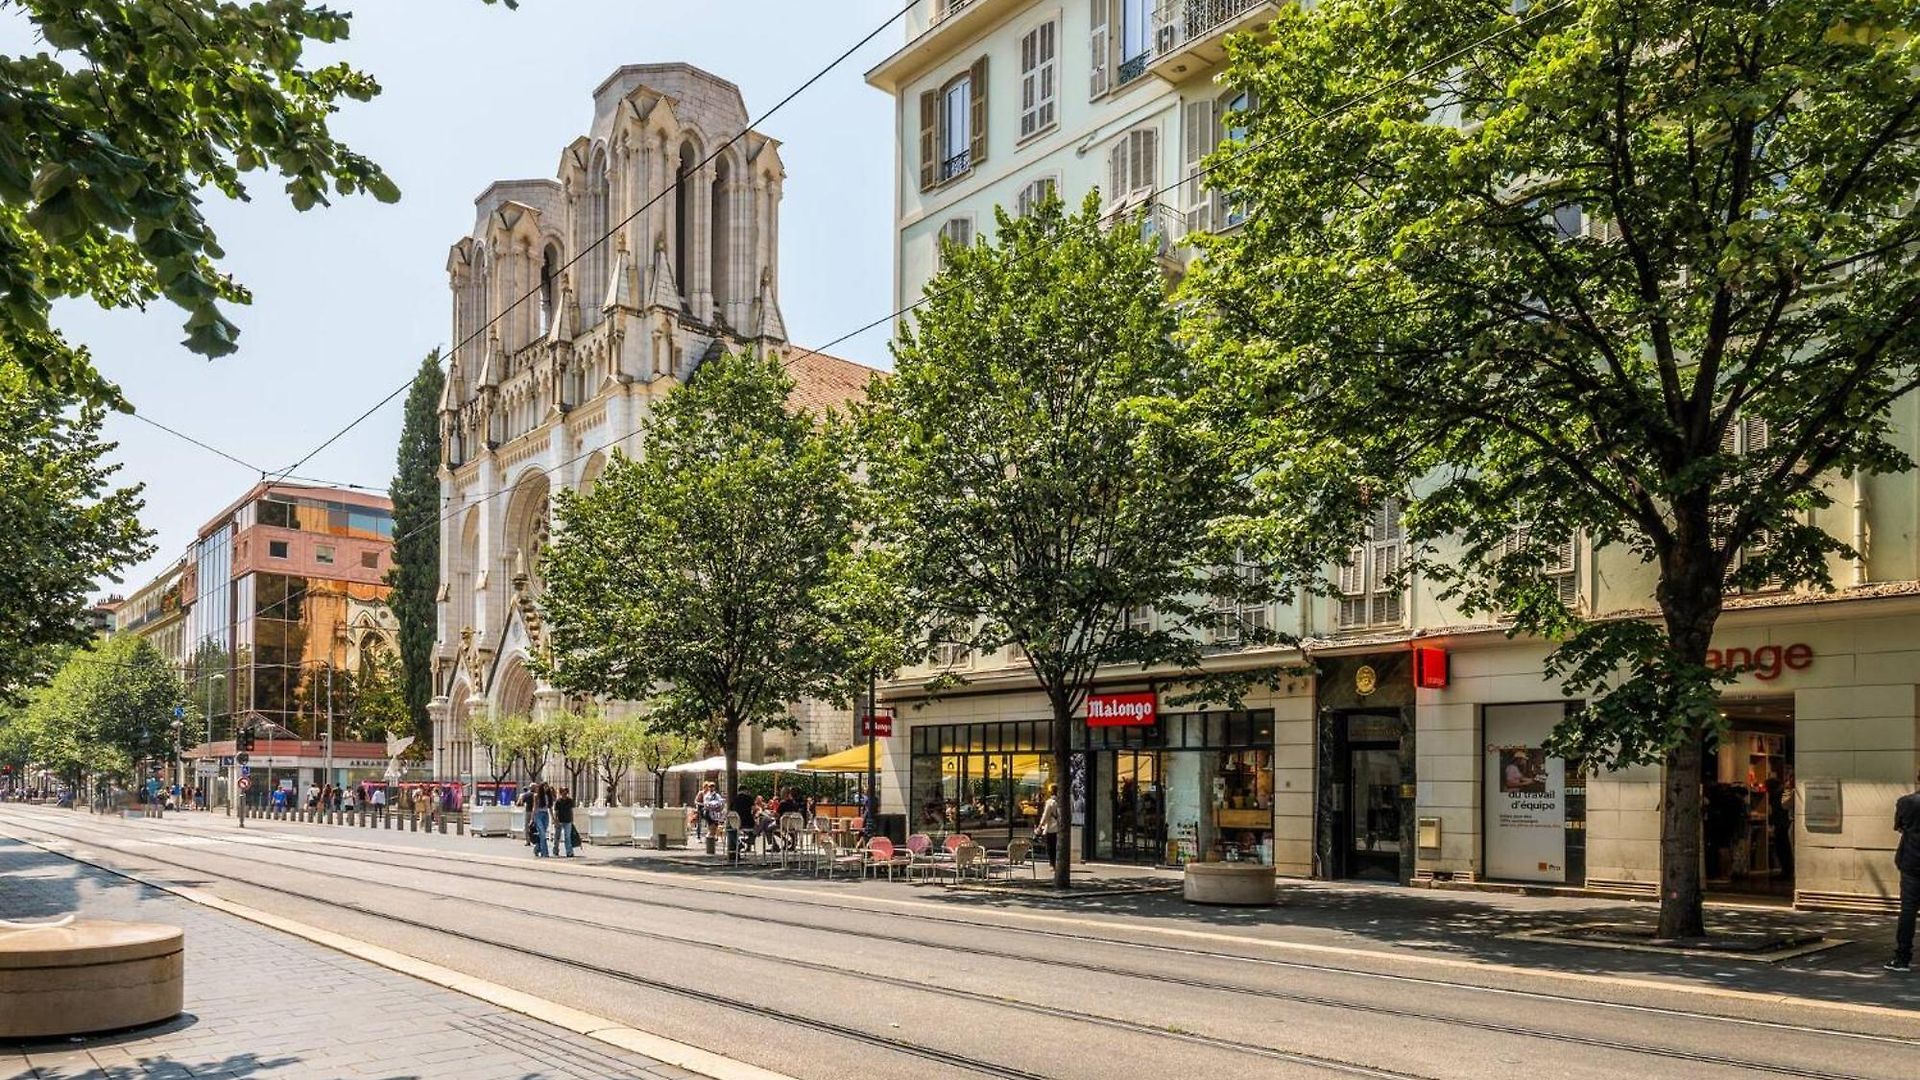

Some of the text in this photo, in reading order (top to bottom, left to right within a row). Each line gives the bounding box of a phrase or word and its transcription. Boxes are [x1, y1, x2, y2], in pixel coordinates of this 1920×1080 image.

[1705, 643, 1814, 682] ange
[1088, 699, 1152, 721] Malongo
[1508, 790, 1556, 799] du travail
